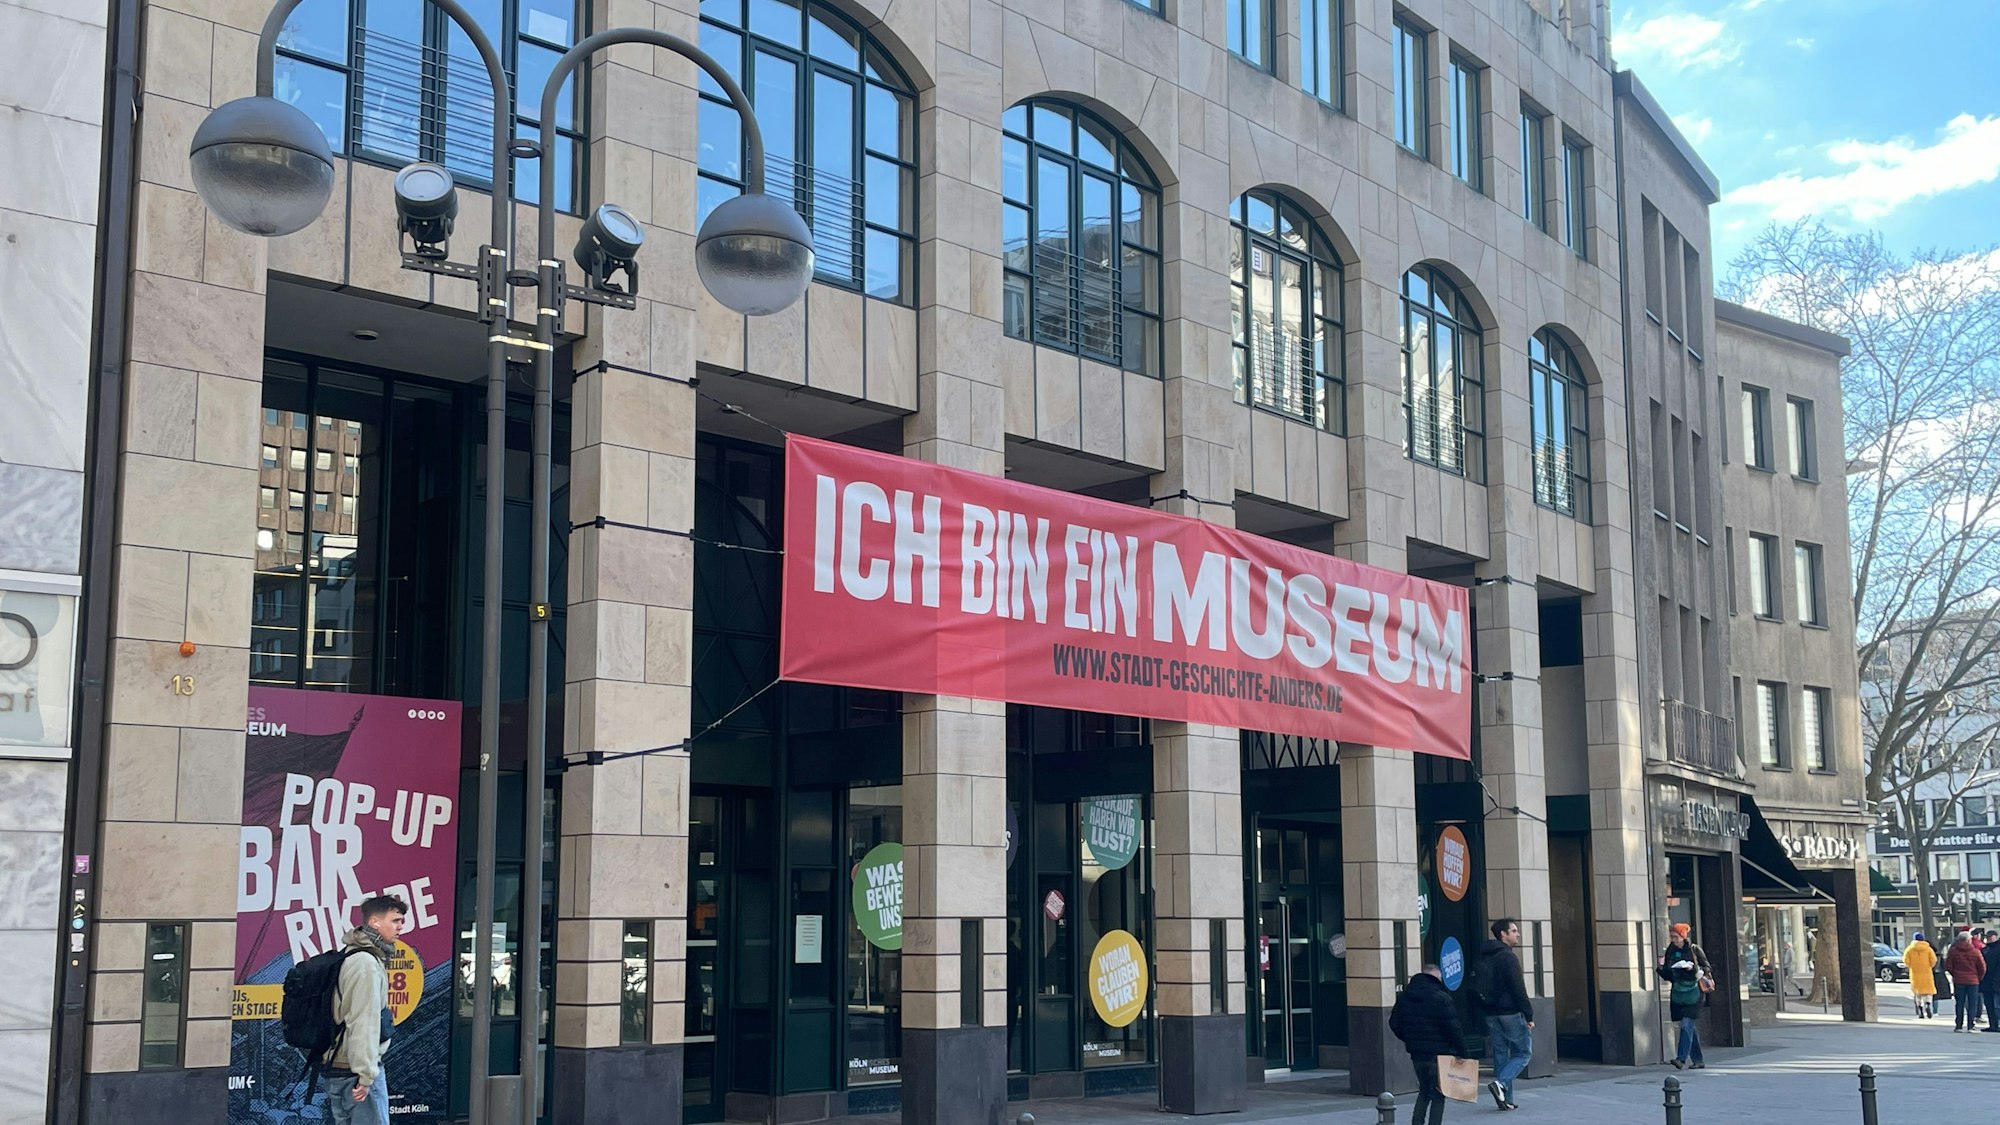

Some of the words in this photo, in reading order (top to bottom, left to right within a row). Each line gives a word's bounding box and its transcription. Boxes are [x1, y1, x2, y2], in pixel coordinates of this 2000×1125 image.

[814, 474, 941, 608] ICH
[961, 503, 1049, 624] BIN
[1064, 523, 1138, 638] EIN
[1153, 541, 1462, 694] MUSEUM
[537, 606, 546, 617] 5
[172, 675, 195, 696] 13
[1053, 643, 1343, 714] WWW.STADT-GESCHICHTE-ANDERS.DE
[279, 773, 453, 848] POP-UP
[1089, 806, 1116, 831] HABEN
[1119, 814, 1135, 836] WIR
[1091, 826, 1132, 855] LUST?
[1974, 833, 1995, 845] für
[237, 824, 365, 912] BAR
[1443, 867, 1463, 889] WIR?
[284, 876, 439, 965] RIKDE
[1098, 944, 1131, 975] WORAN
[1444, 961, 1461, 979] 2023
[1098, 960, 1140, 997] GLAUBEN
[246, 1002, 278, 1016] STAGE
[1104, 981, 1138, 1012] WIR?
[389, 1104, 410, 1114] Stadt
[411, 1103, 429, 1113] Köln
